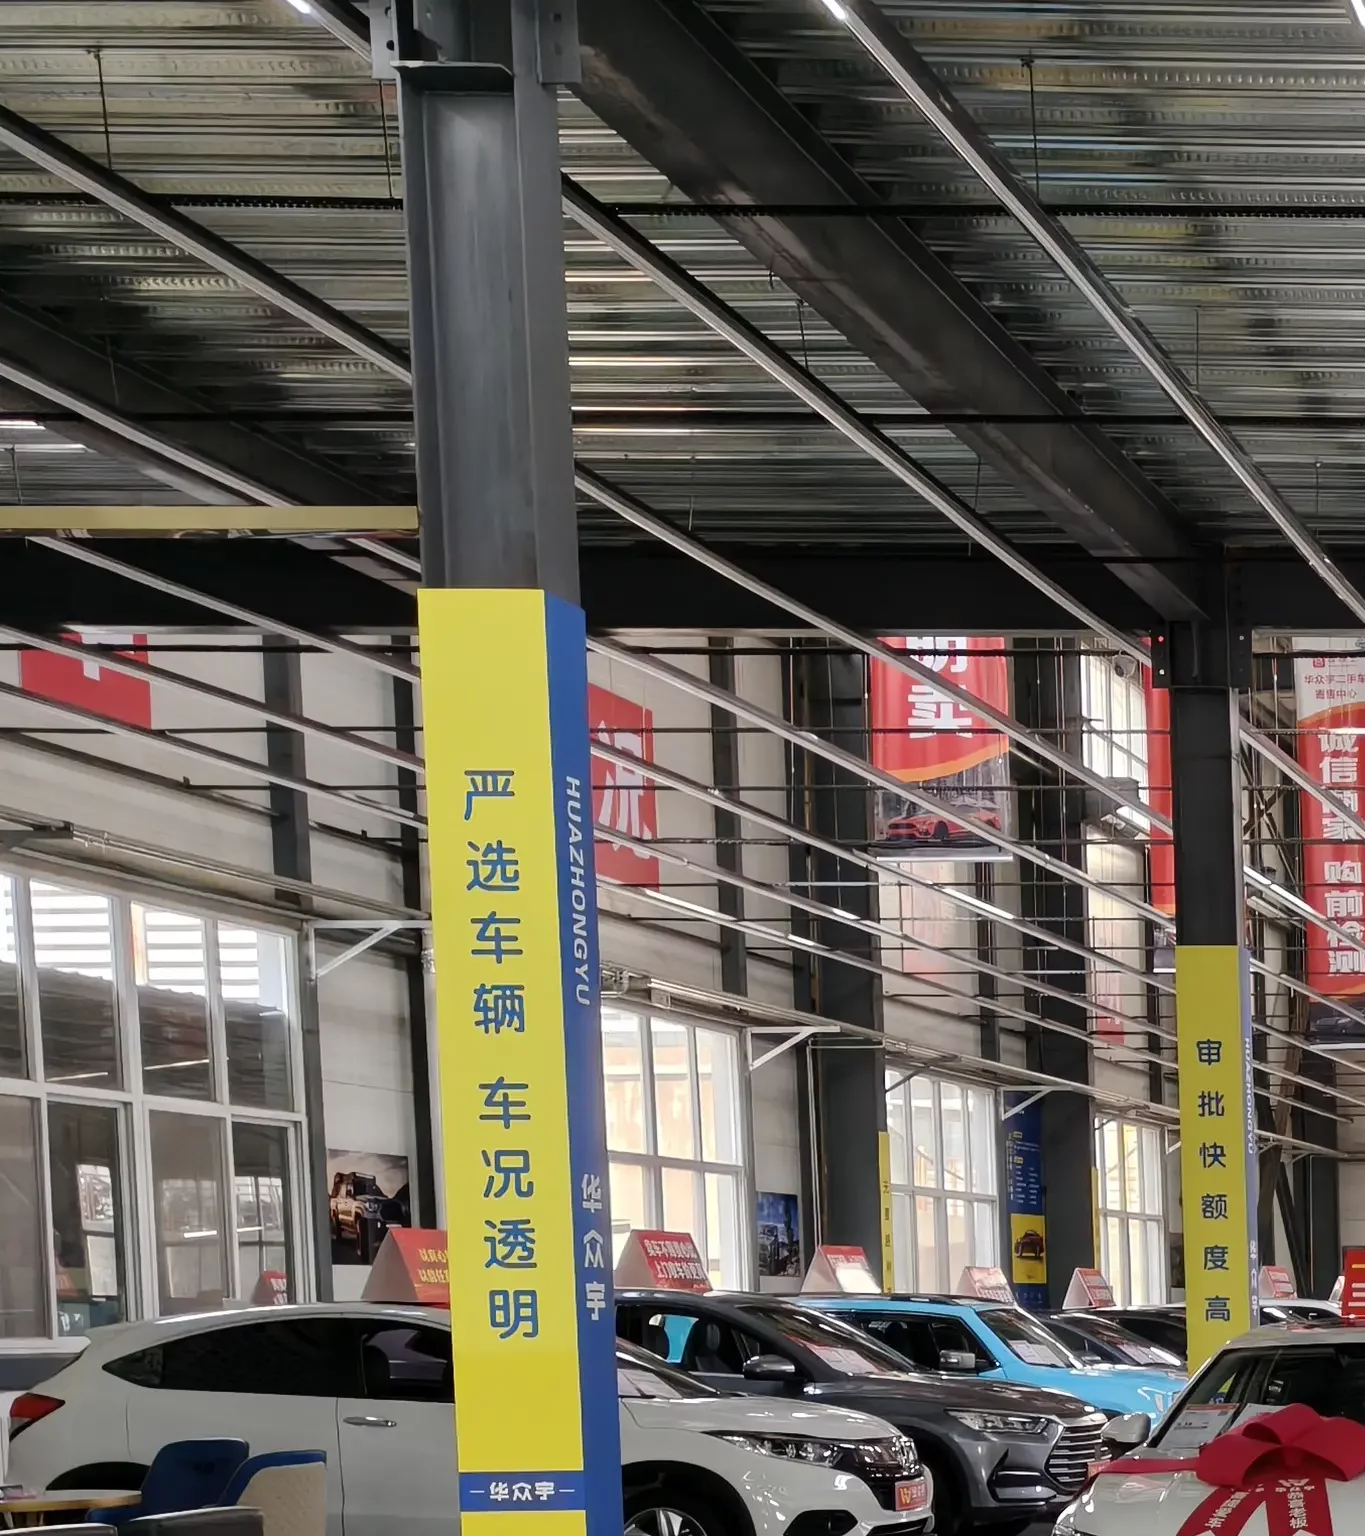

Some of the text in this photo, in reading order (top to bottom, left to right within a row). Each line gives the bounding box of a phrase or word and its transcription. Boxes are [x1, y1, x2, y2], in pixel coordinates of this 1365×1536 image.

[565, 775, 591, 1006] HUAZHONGYU
[464, 769, 540, 1341] 严选车辆 车况透明
[581, 1173, 607, 1321] 华众宇
[1196, 1038, 1231, 1323] 审批快额度高
[489, 1482, 557, 1501] 华众宇
